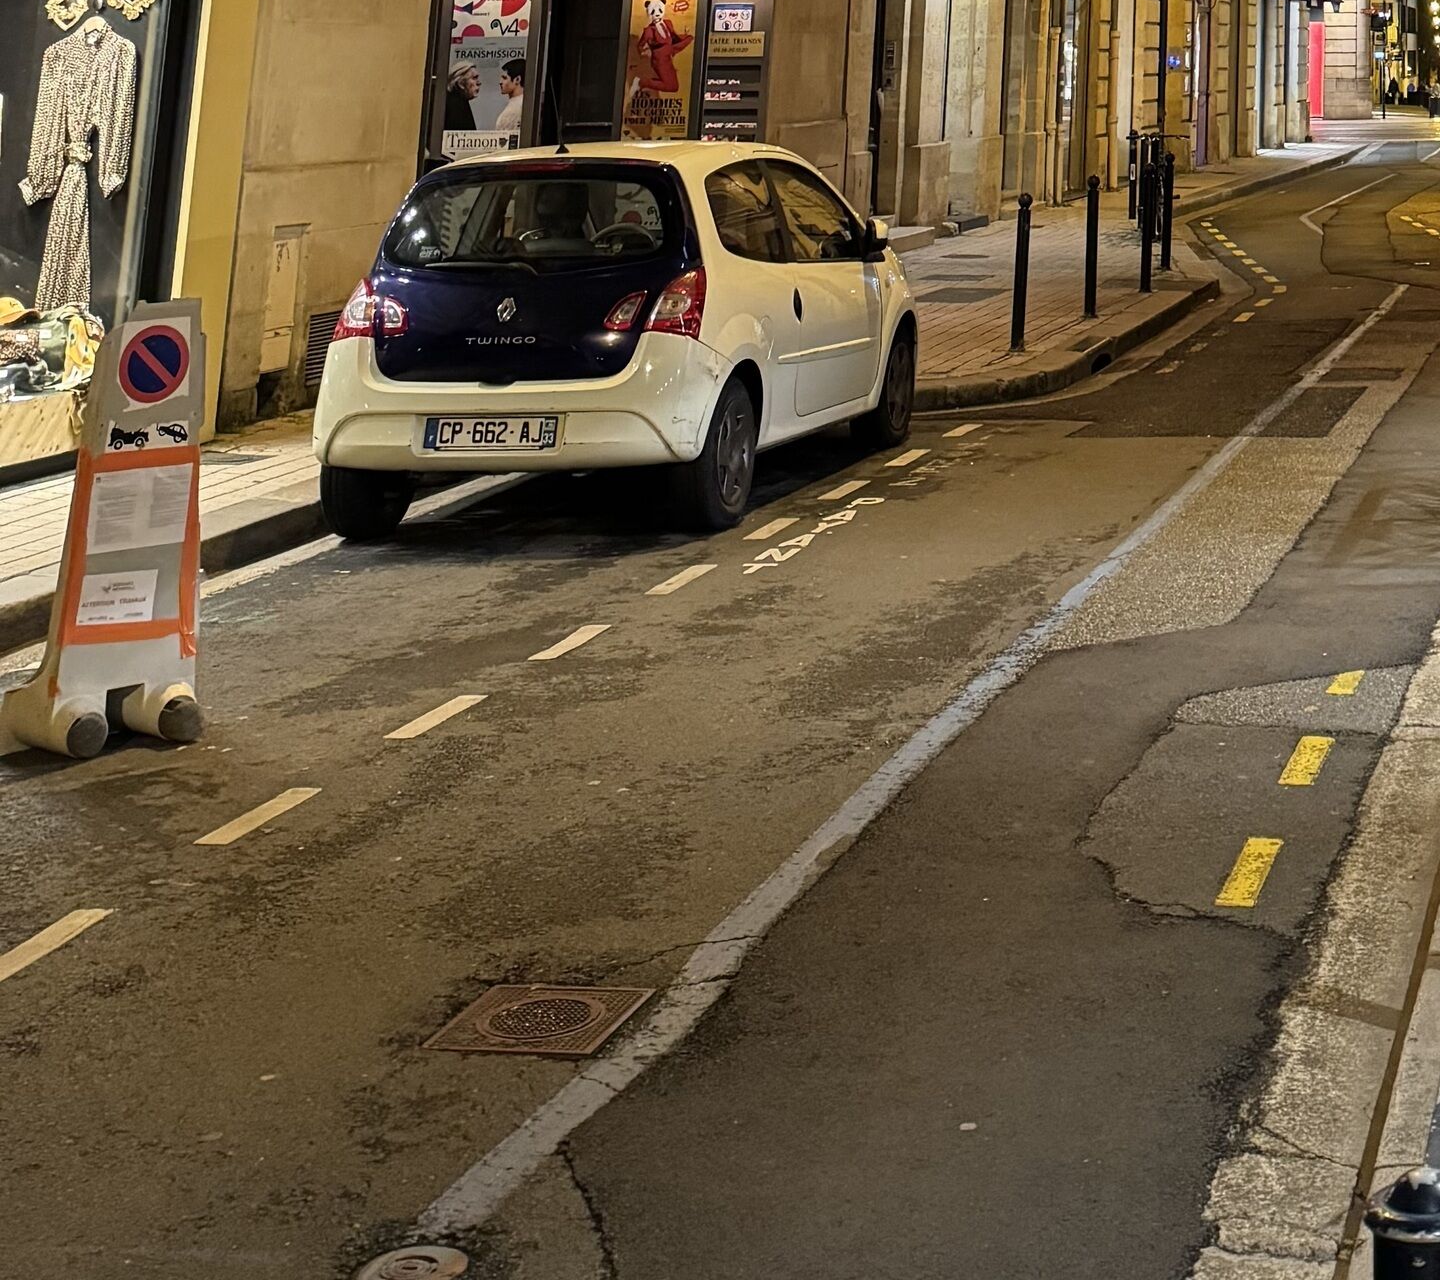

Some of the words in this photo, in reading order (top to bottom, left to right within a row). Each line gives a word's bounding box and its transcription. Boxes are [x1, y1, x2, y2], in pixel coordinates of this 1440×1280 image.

[455, 49, 525, 59] TRANSMISSION
[631, 98, 683, 109] HOMMES
[650, 116, 686, 125] MENTIR
[447, 132, 498, 149] Trianon
[465, 335, 536, 345] TWINGO
[543, 433, 554, 444] 33
